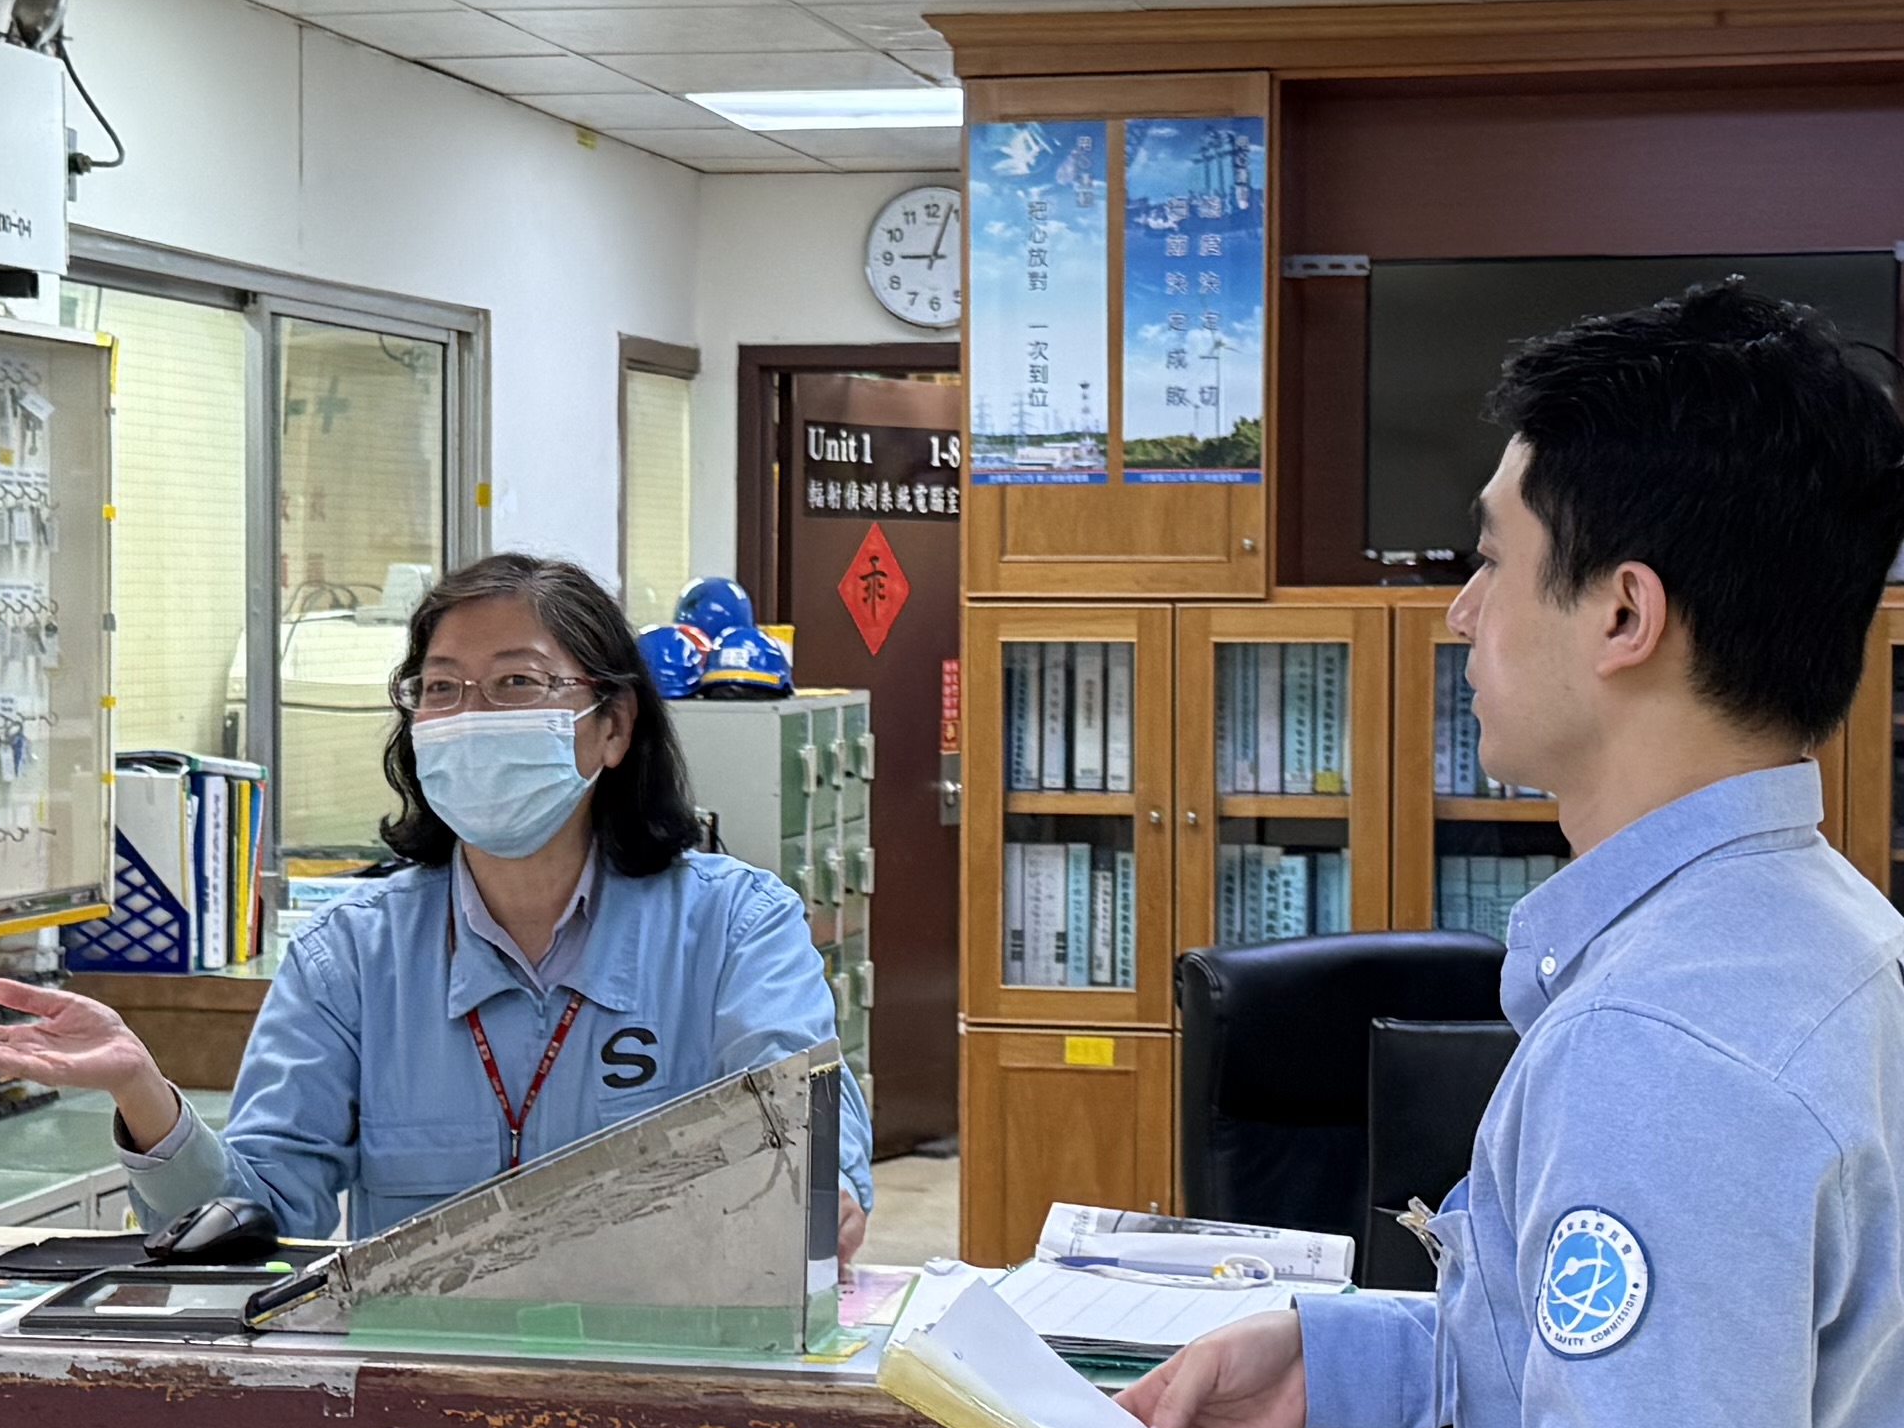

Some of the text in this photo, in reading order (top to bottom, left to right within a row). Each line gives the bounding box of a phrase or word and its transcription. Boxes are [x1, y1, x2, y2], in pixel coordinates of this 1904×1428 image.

[903, 211, 916, 224] 11
[924, 203, 940, 218] 12
[887, 228, 904, 242] 10
[882, 251, 894, 266] 9
[890, 276, 901, 290] 8
[907, 292, 919, 306] 7
[929, 297, 941, 311] 6
[601, 1027, 658, 1089] S
[1555, 1293, 1637, 1346] SAFETY COMMISSION
